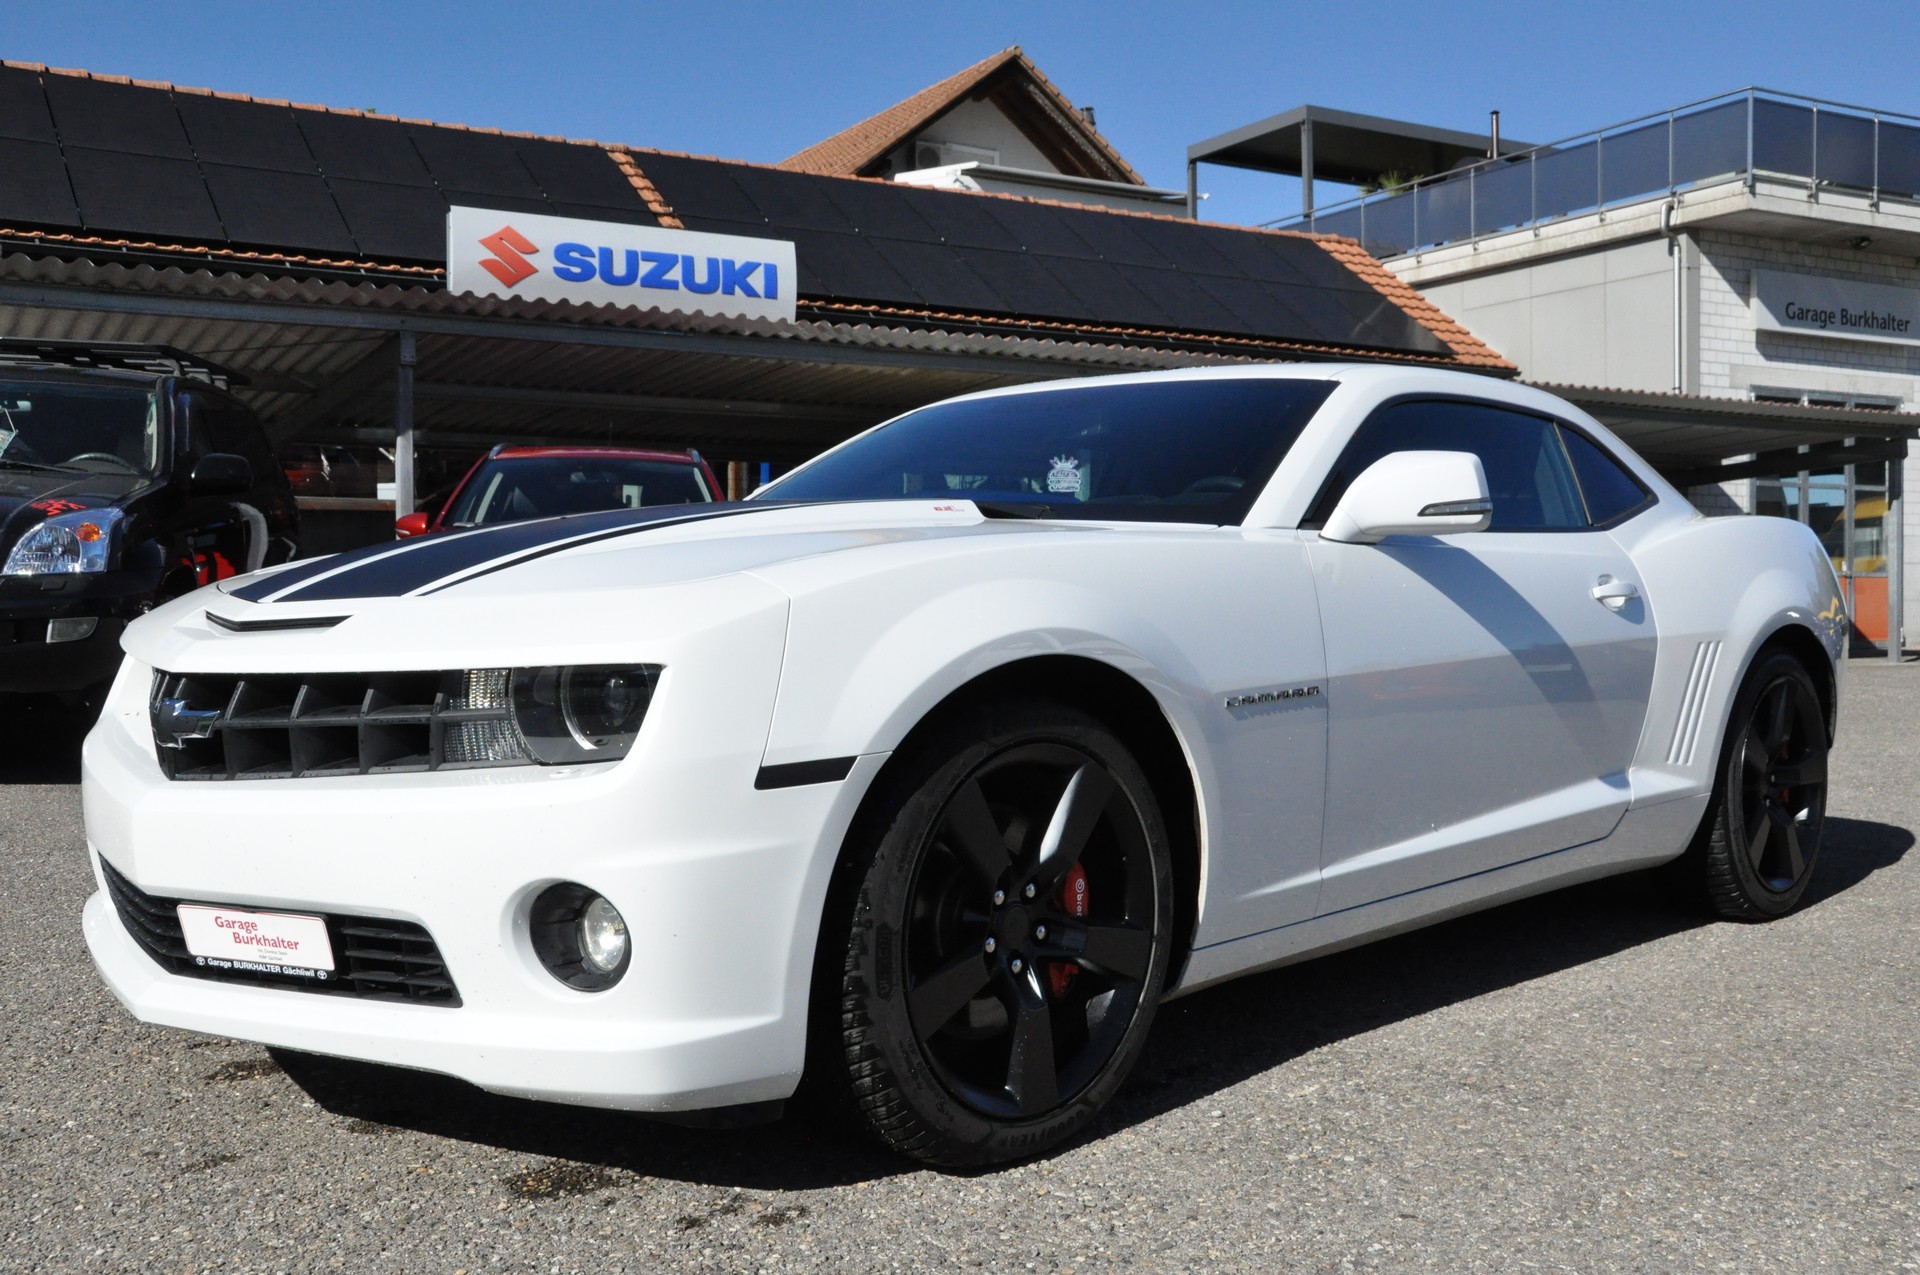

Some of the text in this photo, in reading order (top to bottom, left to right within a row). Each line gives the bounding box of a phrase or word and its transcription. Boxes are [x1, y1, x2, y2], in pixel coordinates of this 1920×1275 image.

[553, 242, 778, 300] SUZUKI
[1785, 302, 1911, 332] Garage Burkhalter
[214, 915, 259, 934] Garage
[232, 932, 300, 950] Burkhalter
[207, 958, 232, 968] Garage
[233, 961, 281, 973] BURKHALTER
